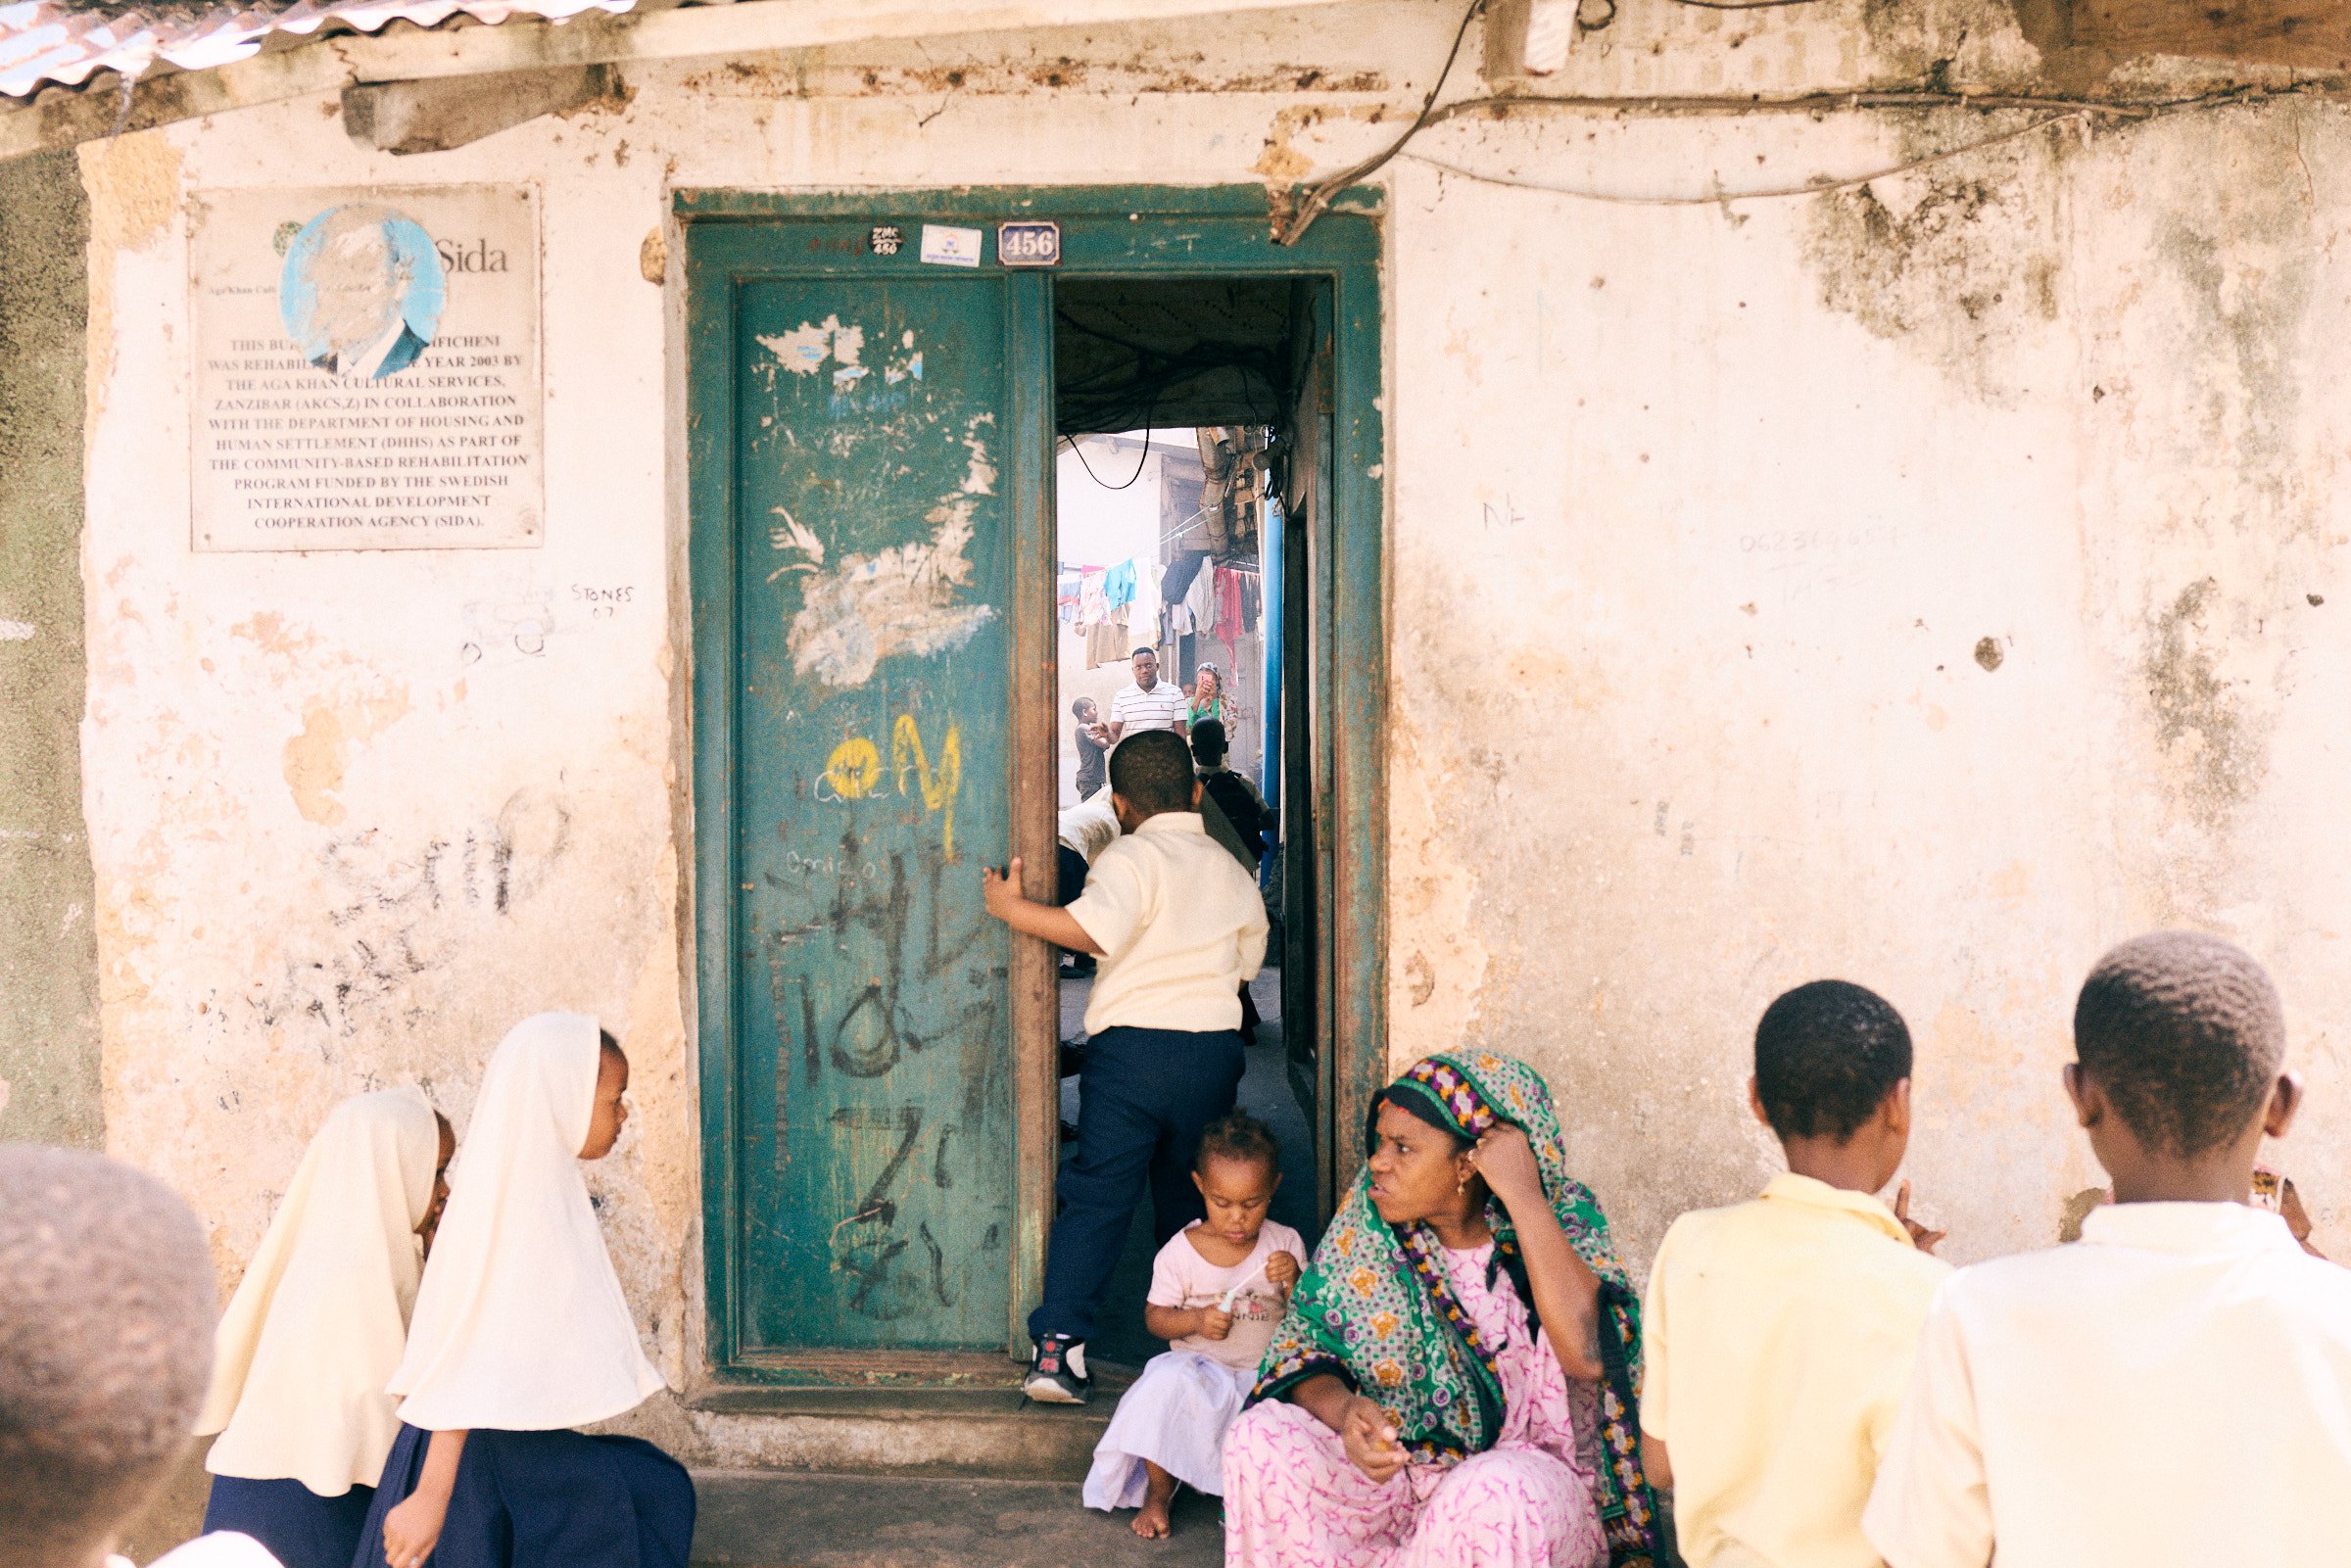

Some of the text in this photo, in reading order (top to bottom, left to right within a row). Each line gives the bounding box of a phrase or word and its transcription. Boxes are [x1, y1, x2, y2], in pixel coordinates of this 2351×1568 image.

[1006, 231, 1054, 257] 456
[433, 238, 508, 273] Sida
[229, 339, 264, 351] THIS
[208, 359, 239, 371] WAS
[244, 358, 312, 370] REHABIL
[425, 356, 465, 368] YEAR
[470, 356, 499, 367] 2003
[504, 355, 523, 366] BY
[226, 379, 257, 391] THE
[262, 379, 291, 390] AGA
[296, 378, 338, 390] KHAN
[343, 376, 425, 390] CULTURAL
[215, 399, 292, 410] ZANZIBAR
[364, 397, 380, 408] IN
[384, 395, 516, 408] COLLABORATION
[208, 414, 525, 430] WITH THE DEPARTMENT OF HOUSING AND
[216, 434, 523, 451] HUMAN SETTLEMENT (DHHS) AS PART OF
[210, 454, 530, 470] THE COMMUNITY-BASED REHABILITATION
[234, 475, 509, 490] PROGRAM FUNDED BY THE SWEDISH
[248, 495, 492, 509] INTERNATIONAL DEVELOPMENT
[255, 517, 363, 529] COOPERATION
[367, 515, 430, 528] AGENCY
[571, 584, 635, 602] STONES
